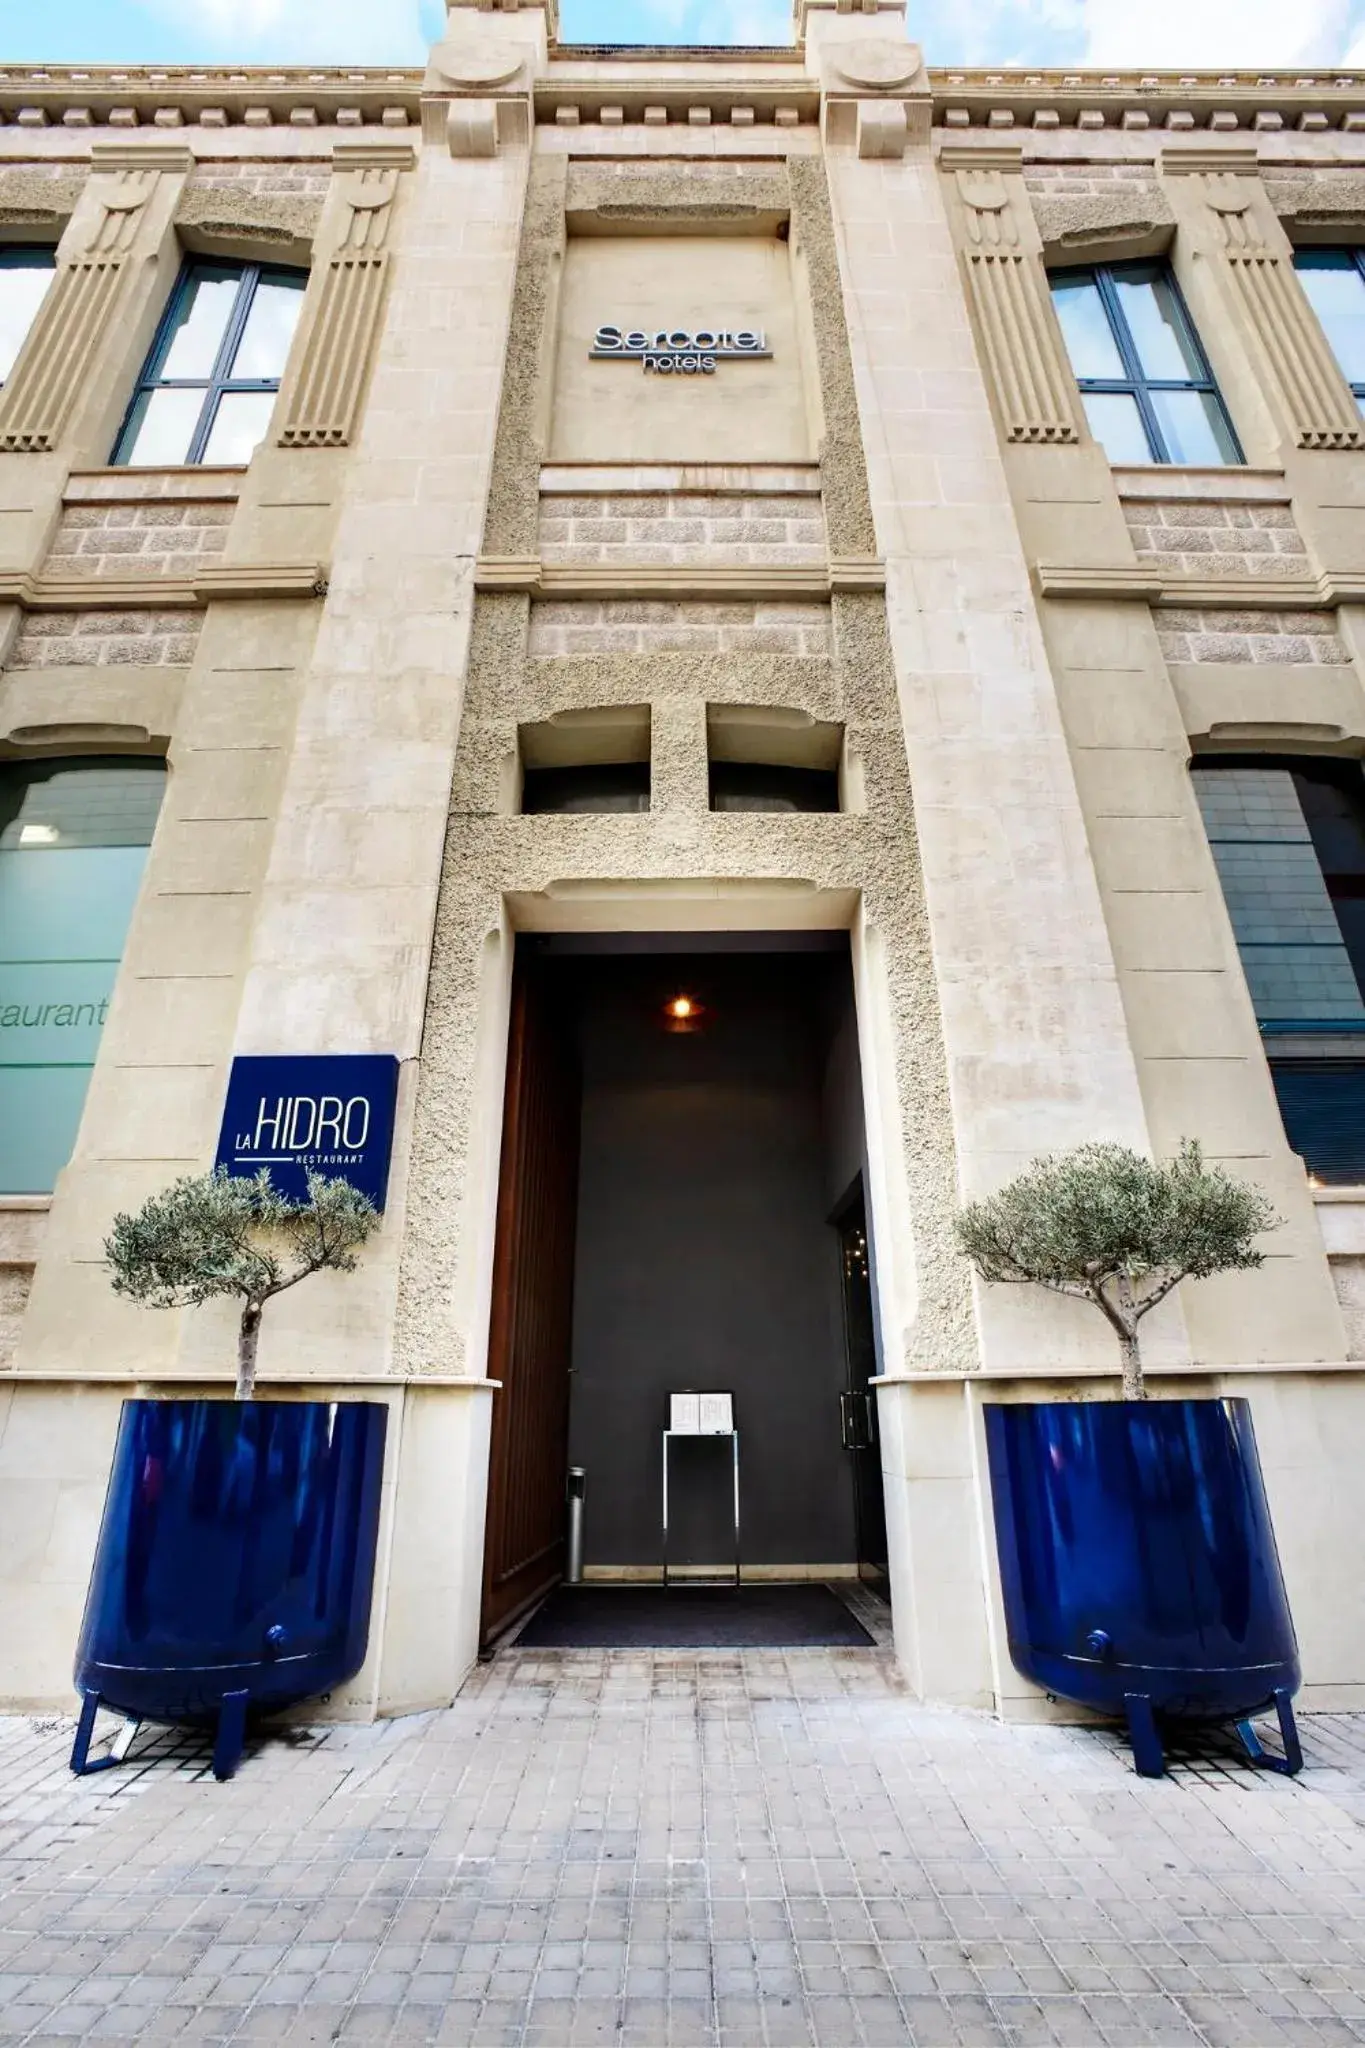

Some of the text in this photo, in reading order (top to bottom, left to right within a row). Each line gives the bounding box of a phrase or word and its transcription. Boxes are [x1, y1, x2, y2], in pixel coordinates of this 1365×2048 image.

[593, 325, 766, 350] Sercotel
[641, 353, 716, 372] hotels
[0, 998, 109, 1027] aurant
[235, 1096, 370, 1150] LA HIDRO
[296, 1154, 364, 1164] RESTAURANT
